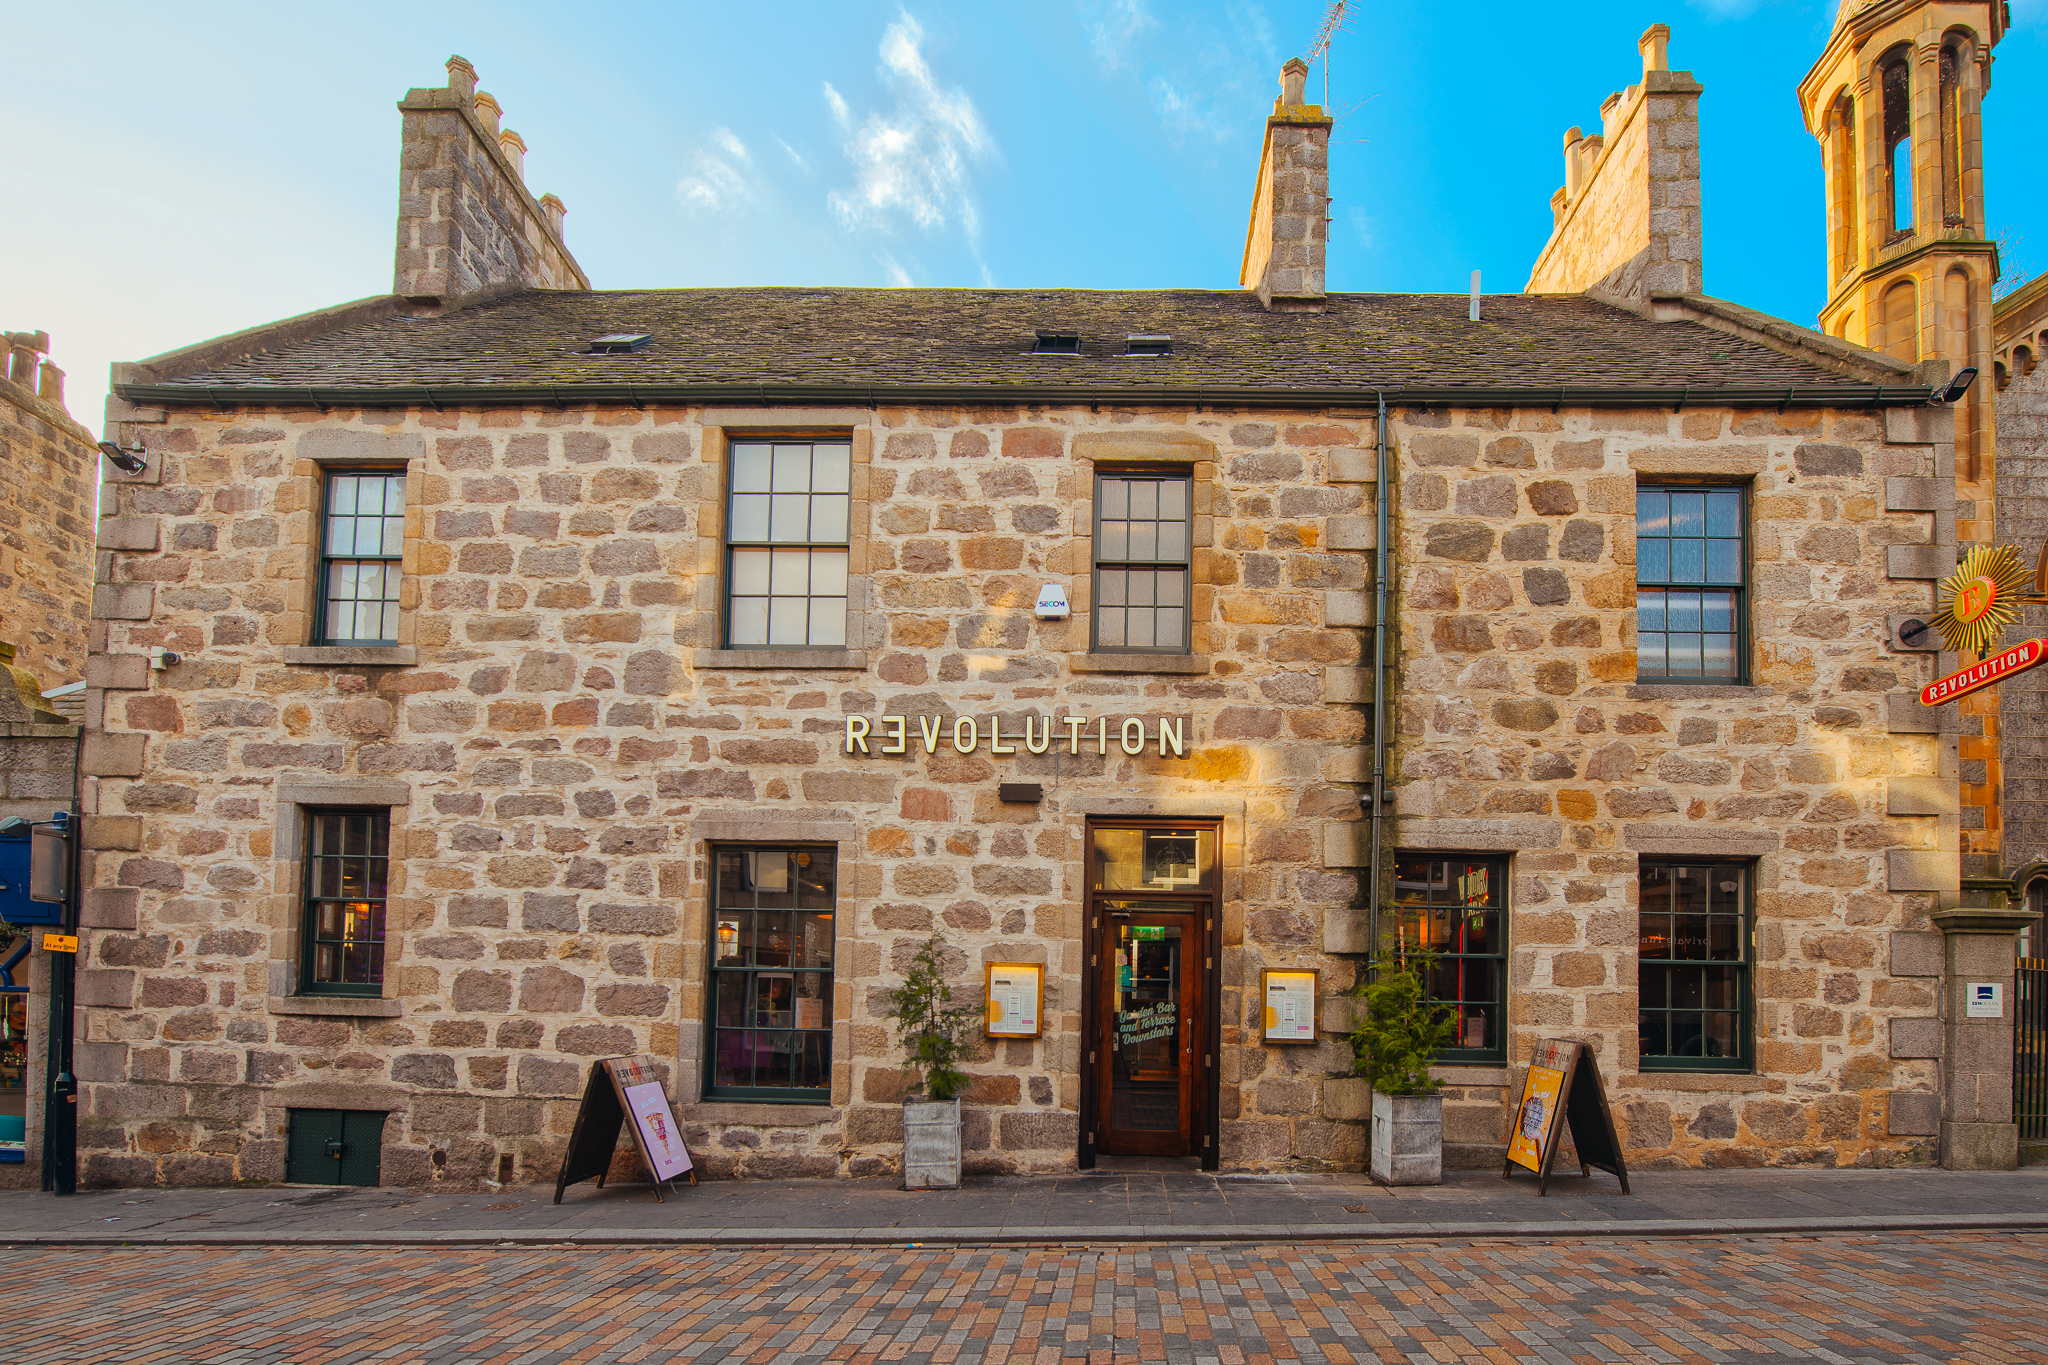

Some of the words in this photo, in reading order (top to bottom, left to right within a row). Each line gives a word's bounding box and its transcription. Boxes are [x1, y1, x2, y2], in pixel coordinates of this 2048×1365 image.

[1959, 586, 1983, 619] R
[1929, 646, 2030, 701] REVOLUTION
[845, 714, 1184, 756] REVOLUTION
[1119, 1007, 1154, 1024] Garden
[1157, 1002, 1176, 1014] Bar
[1120, 1019, 1139, 1033] and
[1141, 1016, 1176, 1030] Terrace
[1122, 1025, 1174, 1045] Downstairs
